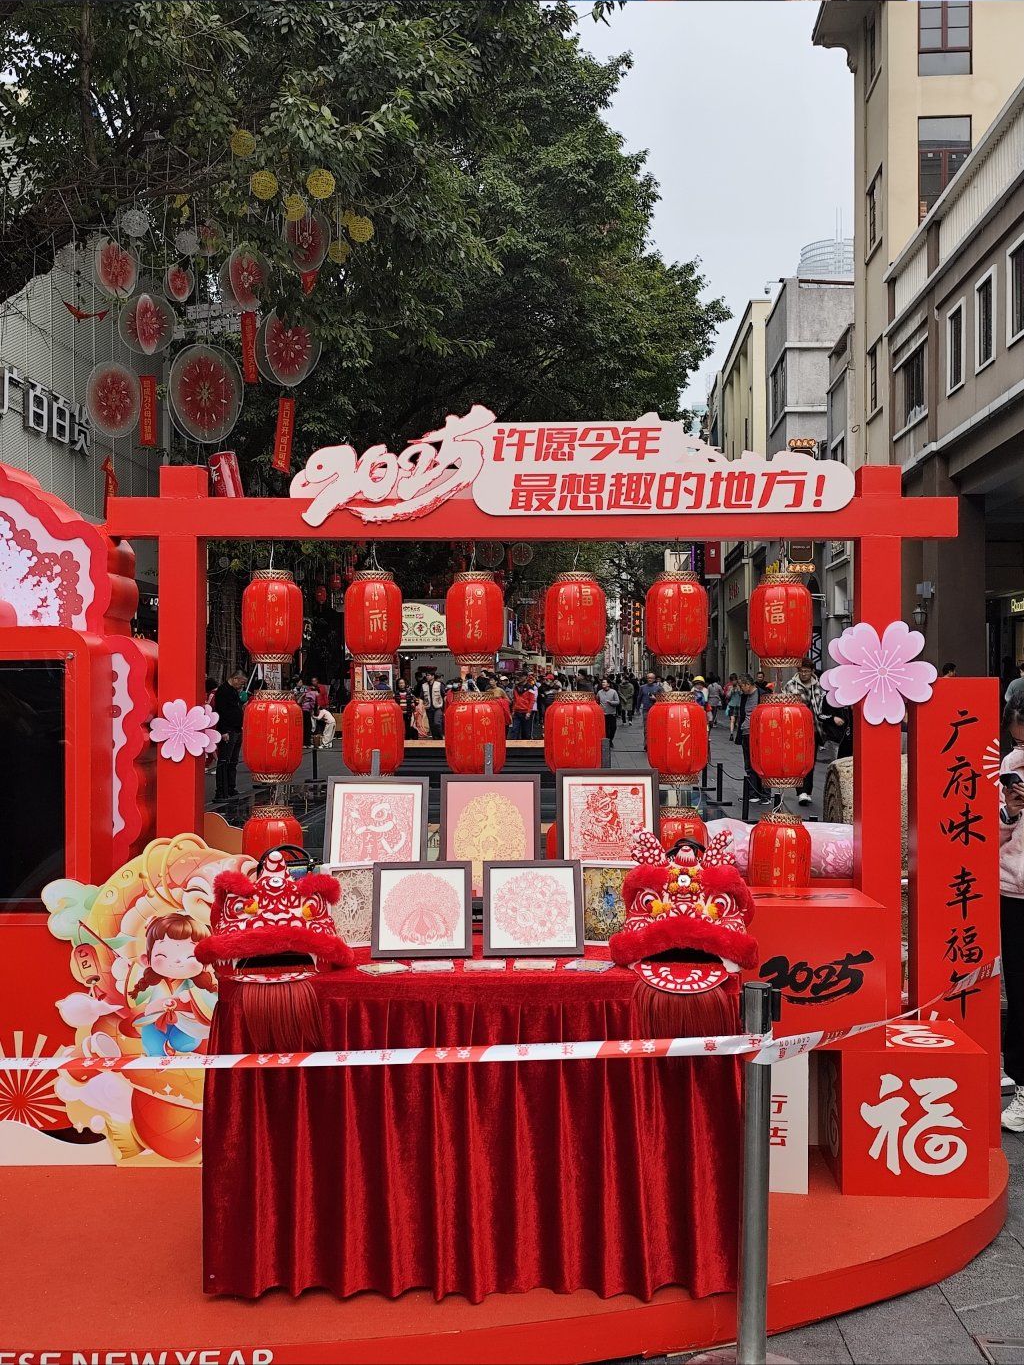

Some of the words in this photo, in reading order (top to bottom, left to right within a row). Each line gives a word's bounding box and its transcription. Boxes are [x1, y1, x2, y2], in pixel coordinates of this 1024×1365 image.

[493, 426, 662, 462] 许愿今年
[939, 710, 986, 847] 广府味
[759, 950, 875, 1006] 2025
[778, 1036, 811, 1049] CAUTION
[860, 1074, 971, 1176] 福
